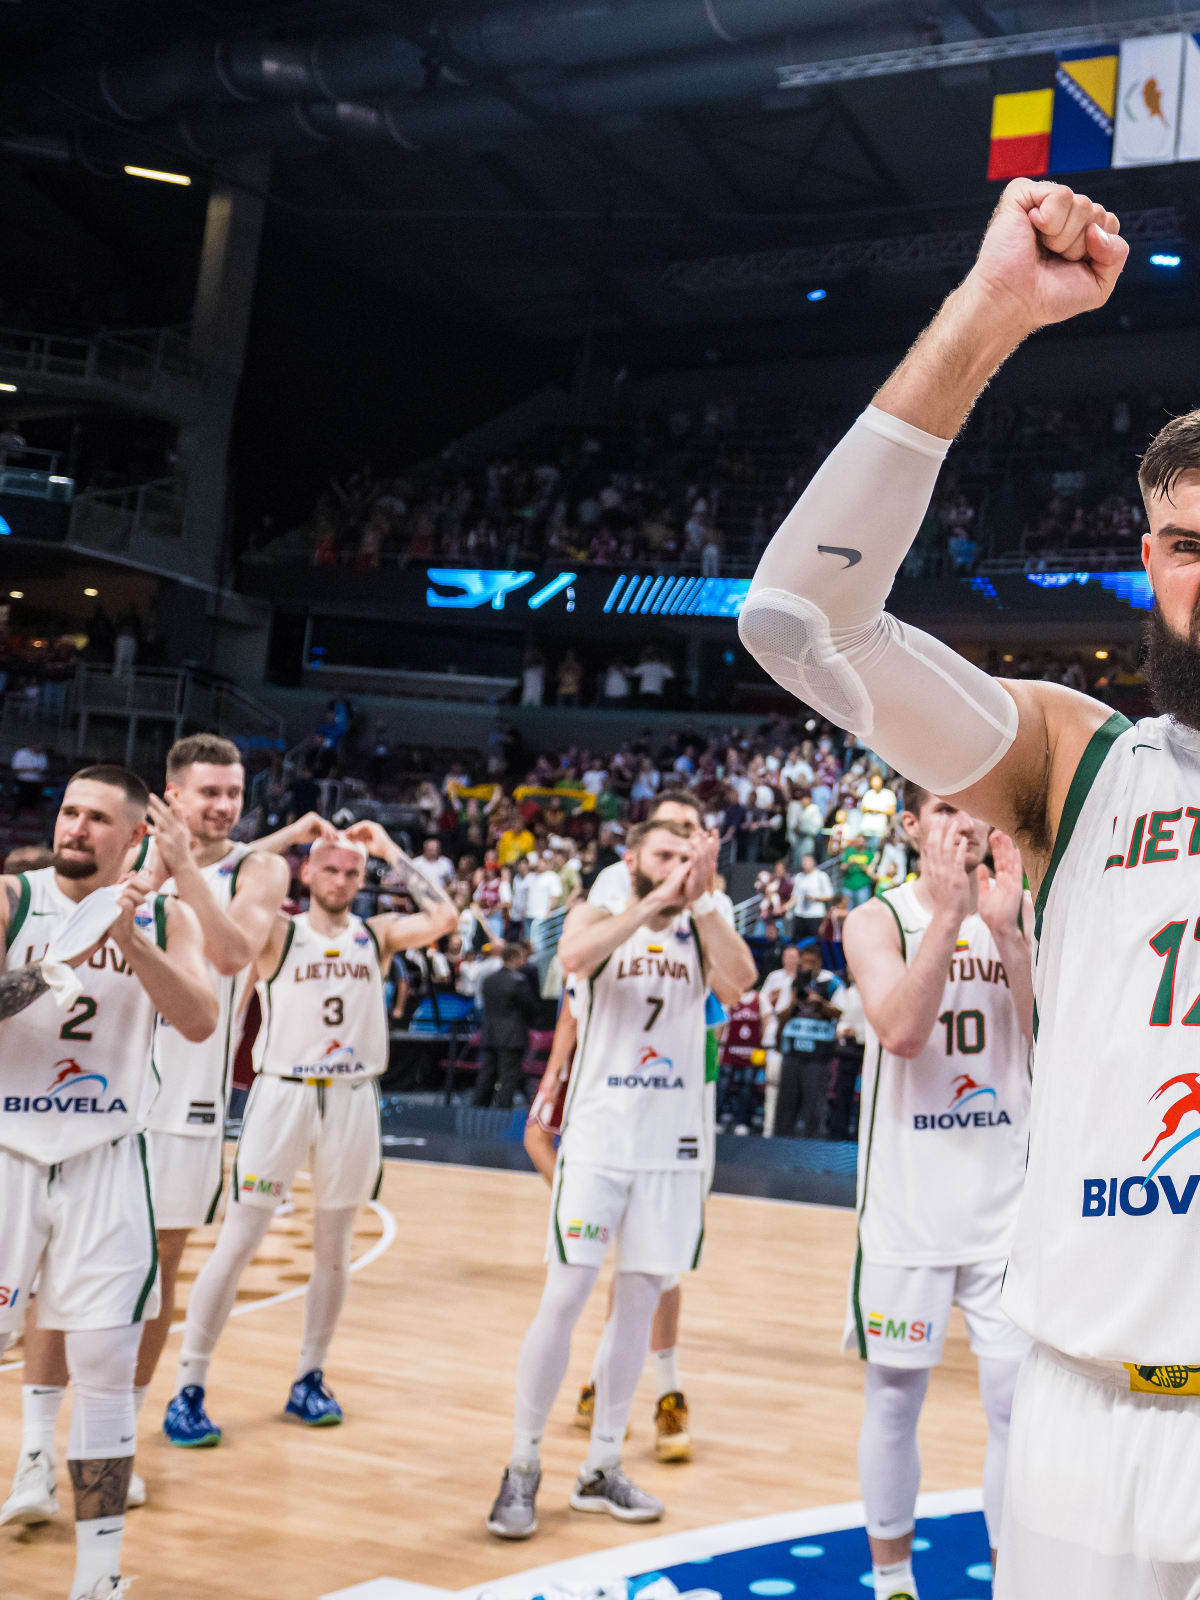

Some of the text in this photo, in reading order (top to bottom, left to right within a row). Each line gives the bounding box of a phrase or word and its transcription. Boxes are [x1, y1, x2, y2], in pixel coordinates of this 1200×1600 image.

[294, 962, 371, 984] LIETUVA
[948, 957, 1010, 989] TUVA
[60, 995, 98, 1041] 2
[322, 996, 345, 1027] 3
[643, 996, 664, 1032] 7
[938, 1009, 986, 1056] 10
[3, 1097, 128, 1114] BIOVELA
[913, 1110, 1012, 1130] BIOVELA
[0, 1286, 19, 1308] SI
